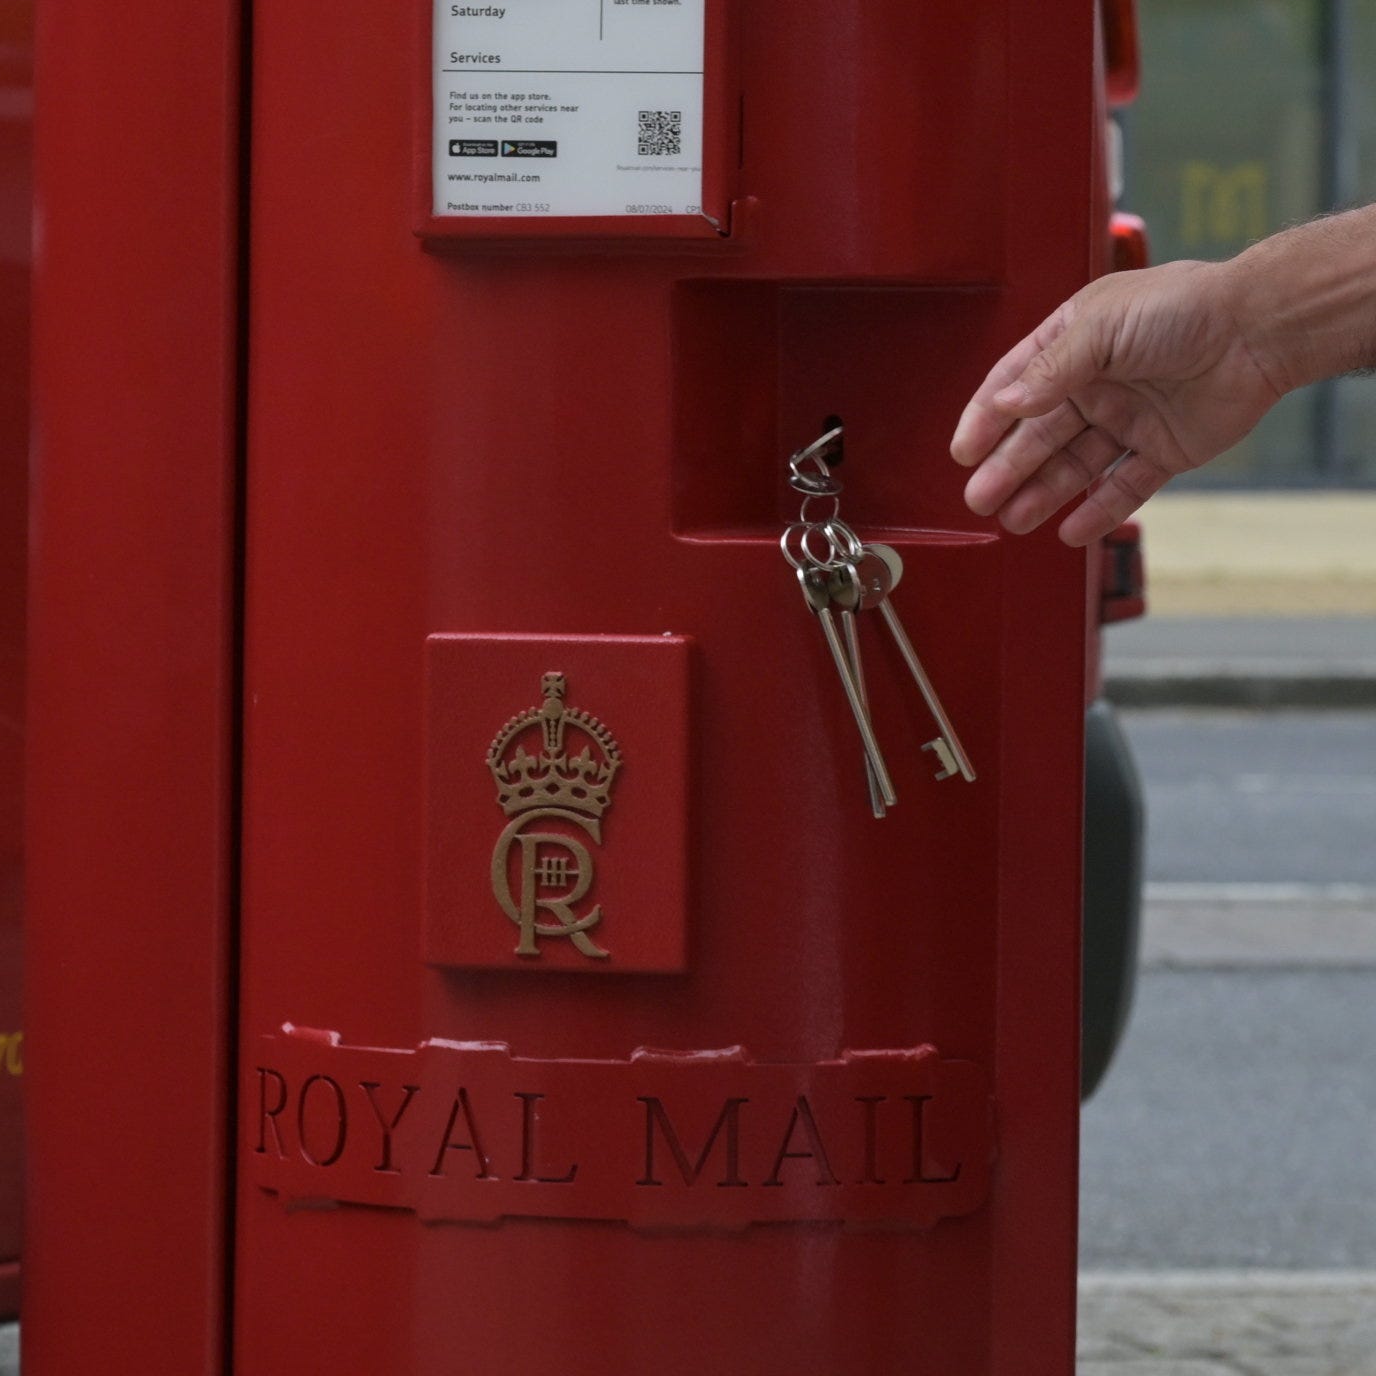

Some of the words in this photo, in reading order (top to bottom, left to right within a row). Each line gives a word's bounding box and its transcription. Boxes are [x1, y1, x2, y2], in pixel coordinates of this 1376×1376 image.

[451, 5, 506, 18] Saturday
[450, 52, 501, 64] Services
[449, 91, 466, 100] Find
[494, 92, 508, 100] the
[510, 93, 526, 102] app
[449, 103, 462, 111] For
[465, 103, 498, 113] locating
[500, 104, 522, 112] other
[525, 104, 558, 112] services
[448, 116, 464, 124] you
[494, 114, 508, 123] the
[510, 115, 522, 124] QR
[525, 115, 544, 124] code
[462, 146, 476, 156] App
[478, 146, 496, 154] Store
[517, 146, 540, 156] Google
[447, 172, 541, 184] www.royalmail.com
[447, 202, 479, 211] Postbox
[482, 203, 514, 212] number
[253, 1065, 579, 1184] ROYAL
[634, 1093, 964, 1188] MAIL
